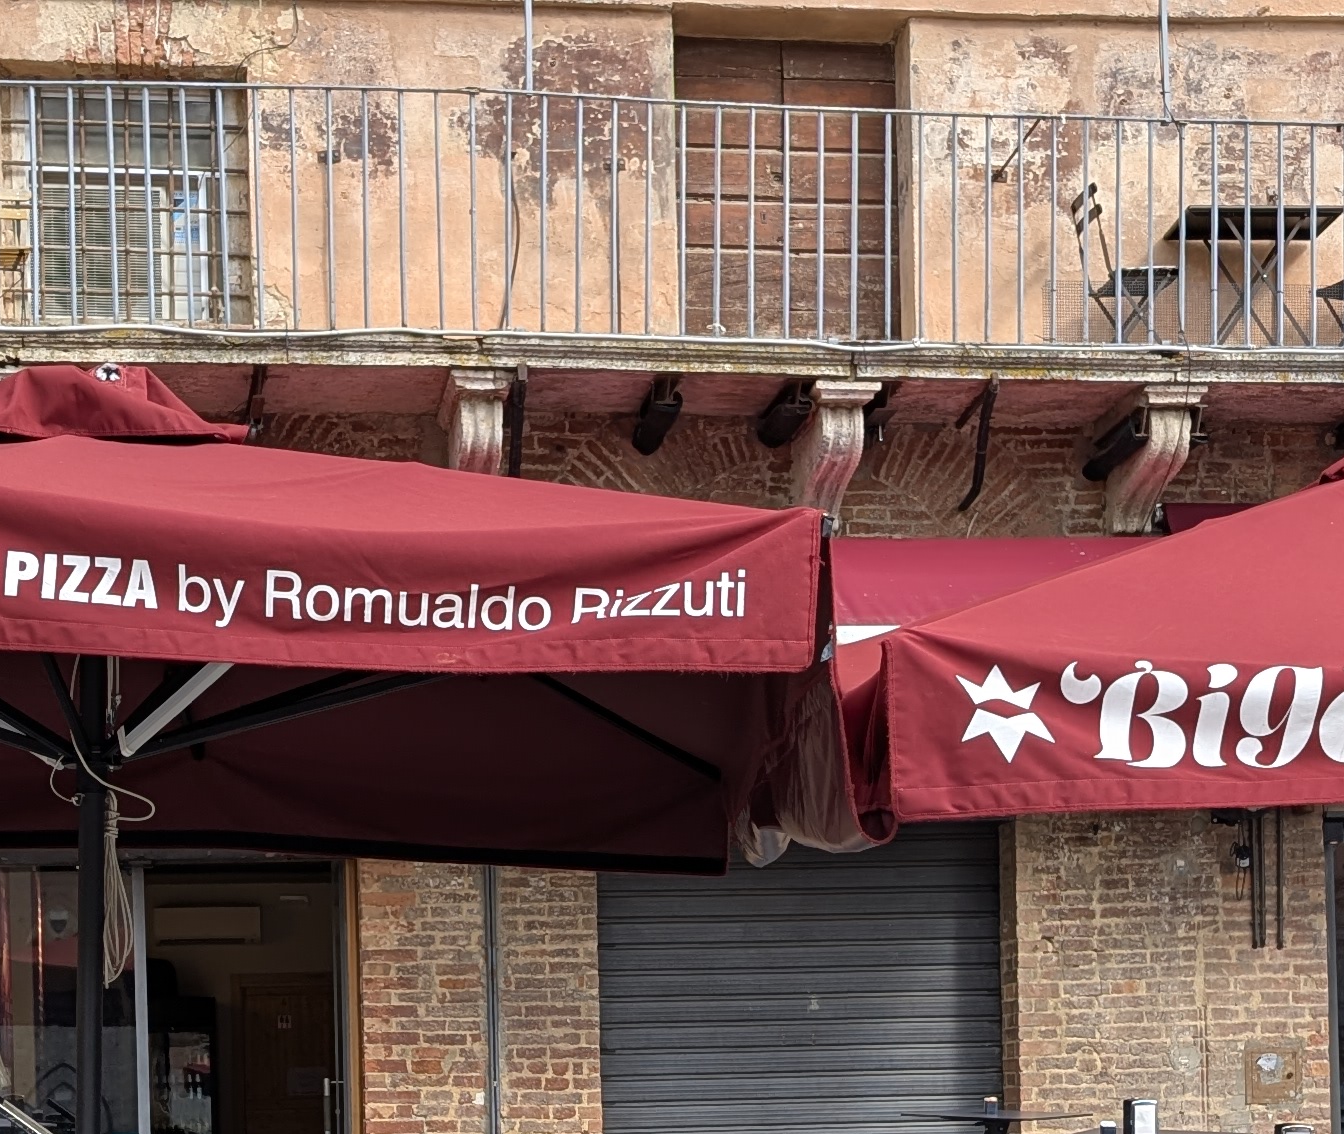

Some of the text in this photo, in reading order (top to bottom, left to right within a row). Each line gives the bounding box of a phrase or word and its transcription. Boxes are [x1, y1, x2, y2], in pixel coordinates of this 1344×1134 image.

[3, 550, 159, 610] PIZZA
[178, 563, 246, 628] by
[265, 569, 552, 632] Romualdo
[571, 568, 746, 624] Rizzuti
